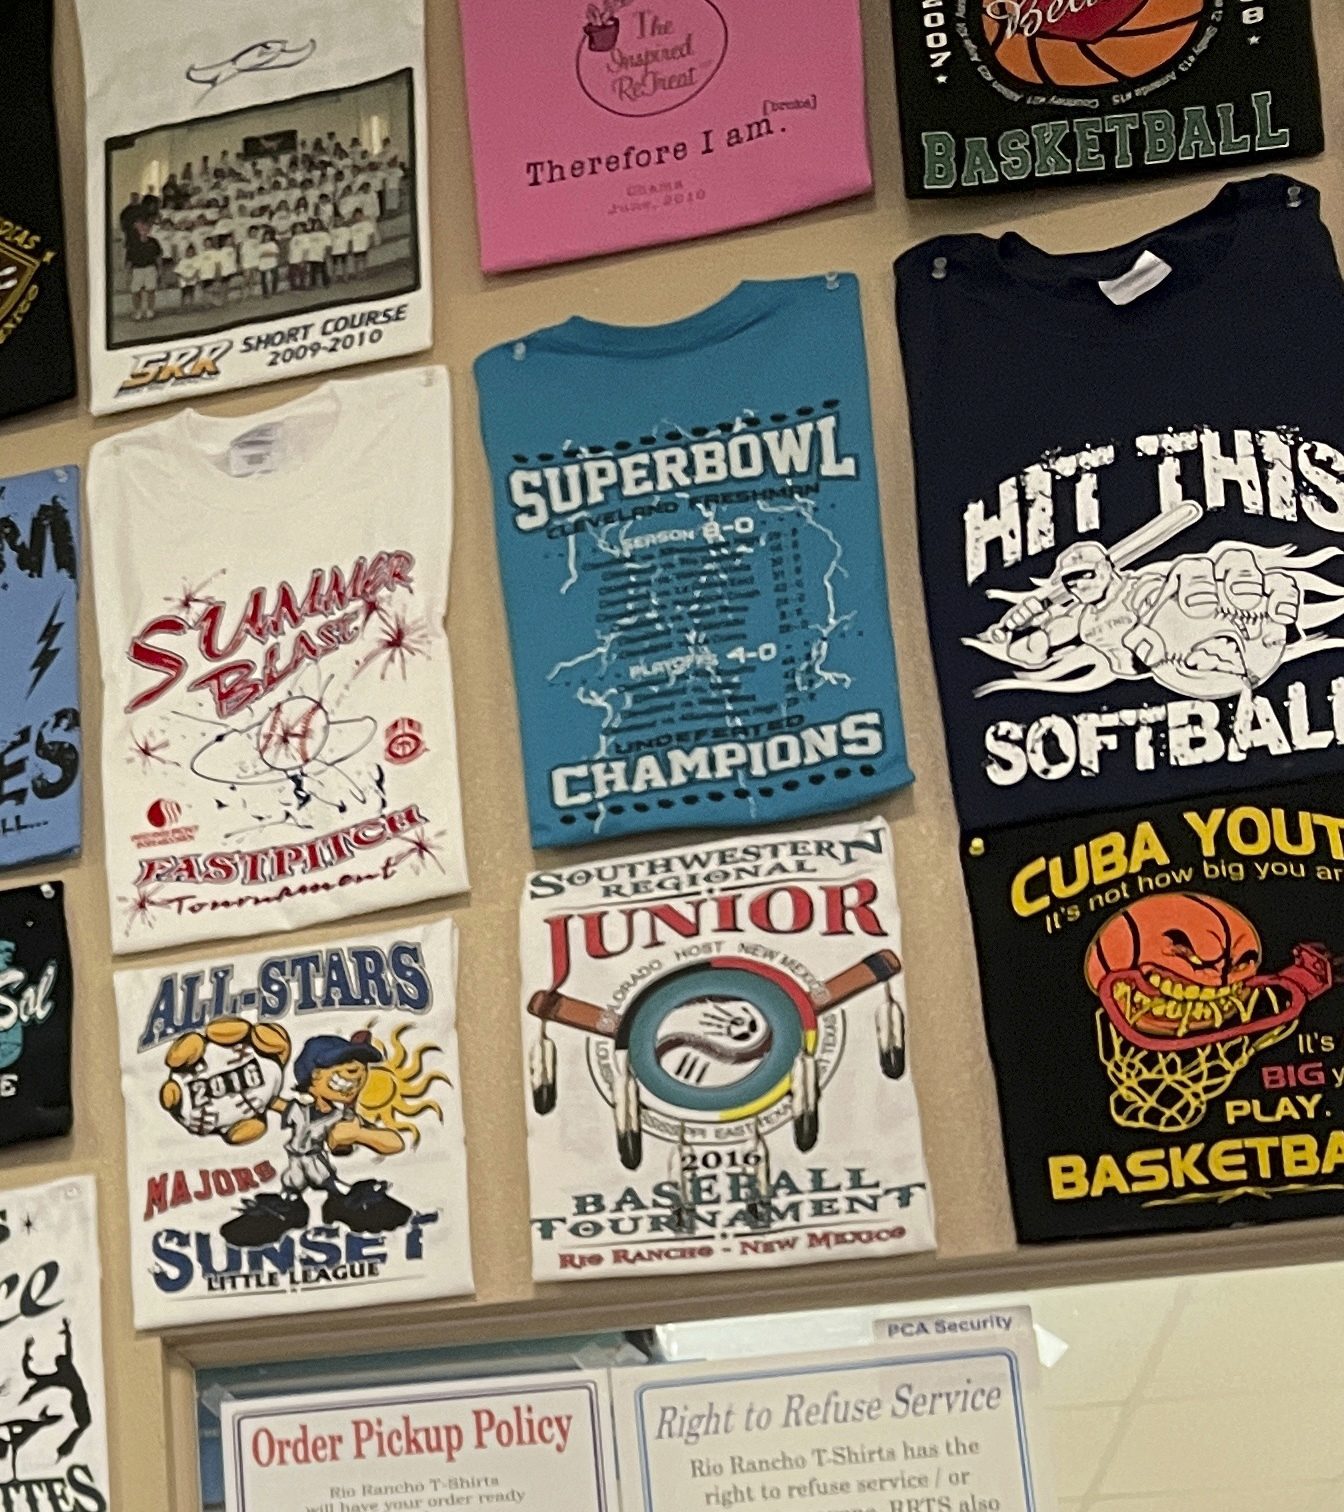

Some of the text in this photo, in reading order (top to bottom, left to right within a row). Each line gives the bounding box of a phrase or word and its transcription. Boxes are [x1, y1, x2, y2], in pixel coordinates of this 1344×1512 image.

[526, 117, 787, 187] Therefore I am.
[922, 90, 1290, 189] BASKETBALL
[240, 303, 410, 353] SHORT COURSE
[267, 328, 384, 368] 2009-2010
[509, 413, 859, 533] SUPERBOWL
[962, 443, 1116, 586] HIT
[123, 549, 416, 716] SUMMER
[549, 710, 886, 810] CHAMPIONS
[133, 803, 431, 888] FASTPITCH
[528, 826, 887, 901] SOUTHWESTERN
[1010, 819, 1172, 919] CUBA
[600, 858, 818, 899] REGIONAL
[1088, 859, 1308, 913] not how big you
[543, 877, 890, 996] JUNIOR
[136, 940, 435, 1055] ALL-STARS
[1261, 1062, 1327, 1090] BIG
[1224, 1093, 1333, 1125] PLAY.
[142, 1159, 279, 1223] MAJORS
[571, 1166, 882, 1218] BASEBALL
[680, 1149, 763, 1174] 2016
[529, 1181, 928, 1242] TOURNAMENT
[288, 1260, 381, 1286] LEAGUE
[610, 1234, 800, 1266] RANCHO NEW
[933, 1312, 1013, 1335] Security
[251, 1405, 574, 1469] Order Pickup Policy
[654, 1378, 1003, 1446] Right to Refuse Service
[728, 1452, 808, 1474] Rancho
